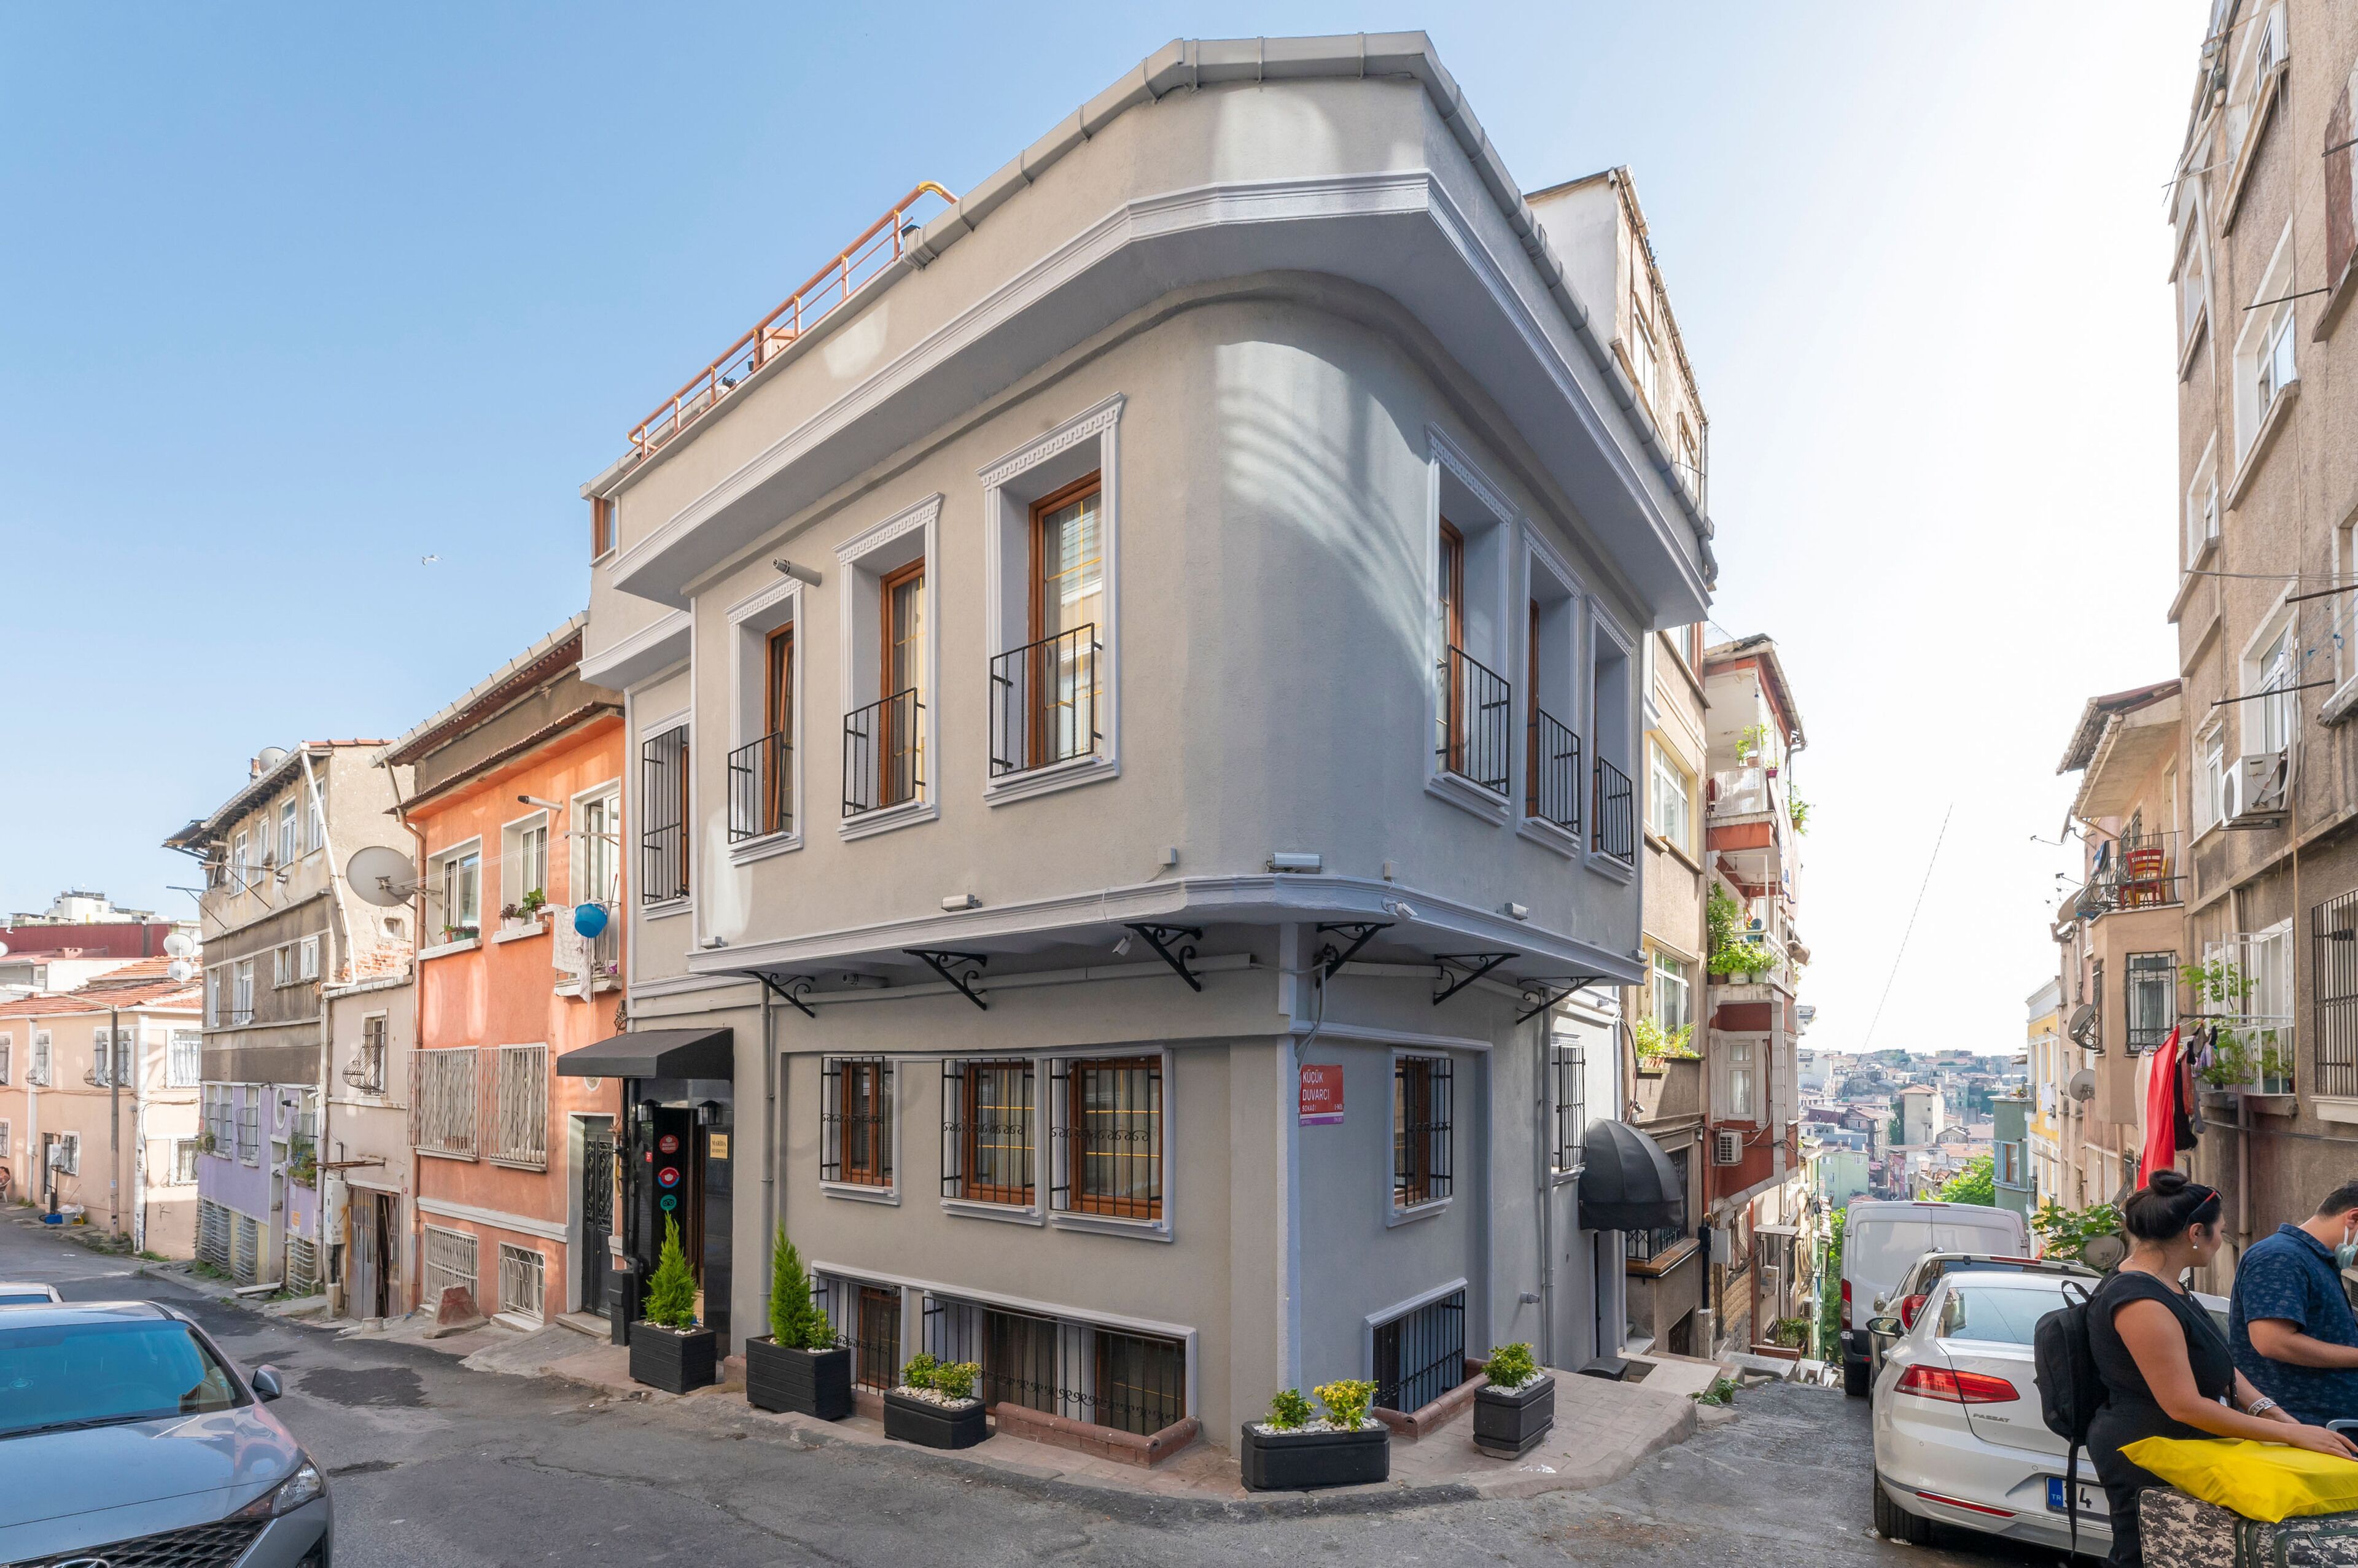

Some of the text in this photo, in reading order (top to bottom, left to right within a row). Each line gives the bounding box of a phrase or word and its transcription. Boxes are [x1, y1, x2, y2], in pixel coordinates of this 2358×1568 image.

[1302, 1069, 1323, 1085] KÜÇÜK
[1302, 1089, 1329, 1101] DUVARCI
[1973, 1413, 2010, 1422] PASSAT
